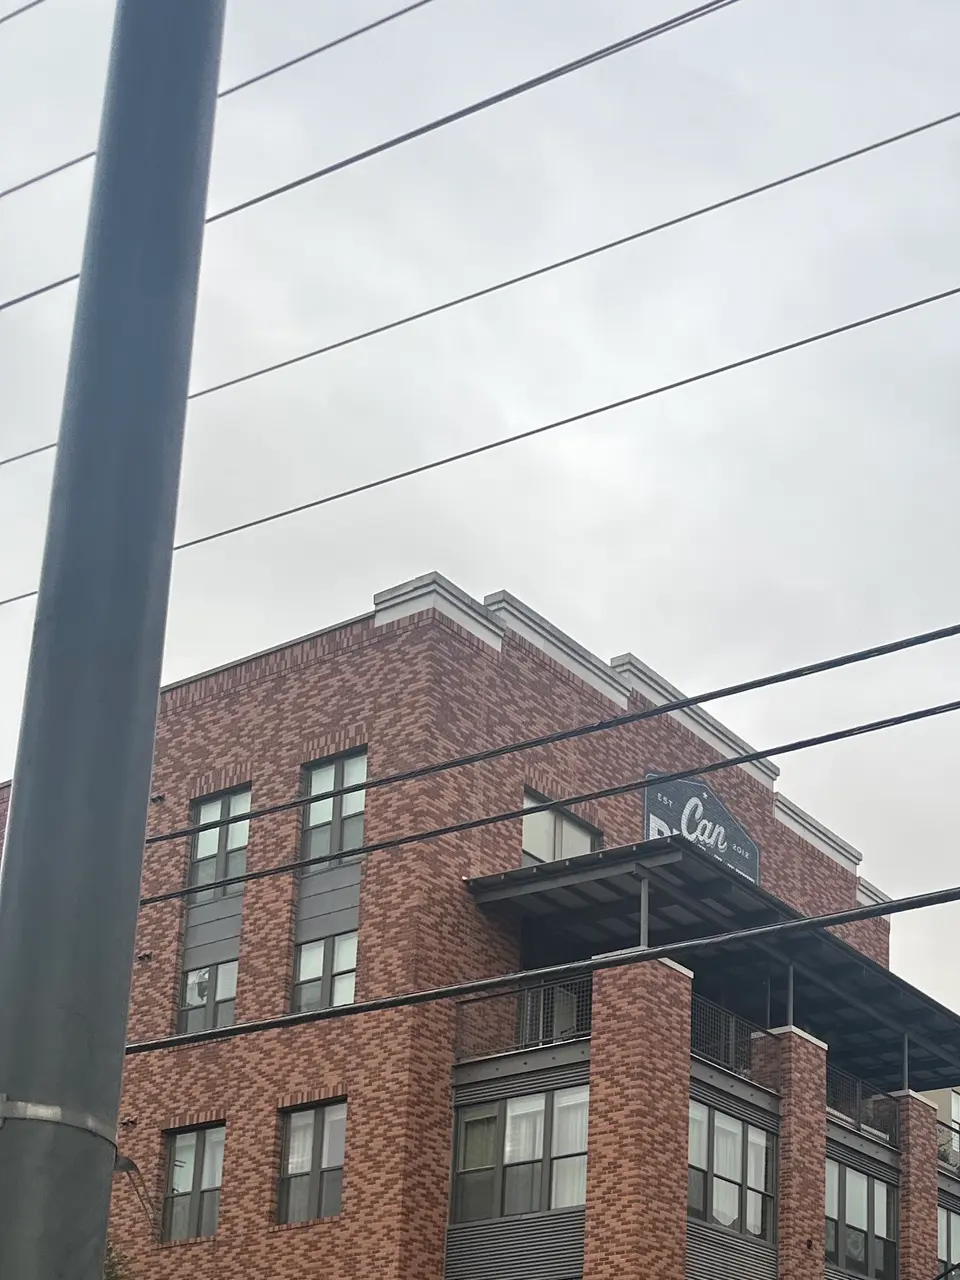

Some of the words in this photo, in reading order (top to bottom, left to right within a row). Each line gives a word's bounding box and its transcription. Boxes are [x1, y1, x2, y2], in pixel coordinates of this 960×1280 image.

[657, 793, 673, 808] EST
[681, 797, 727, 853] Can
[732, 844, 750, 859] 2012
